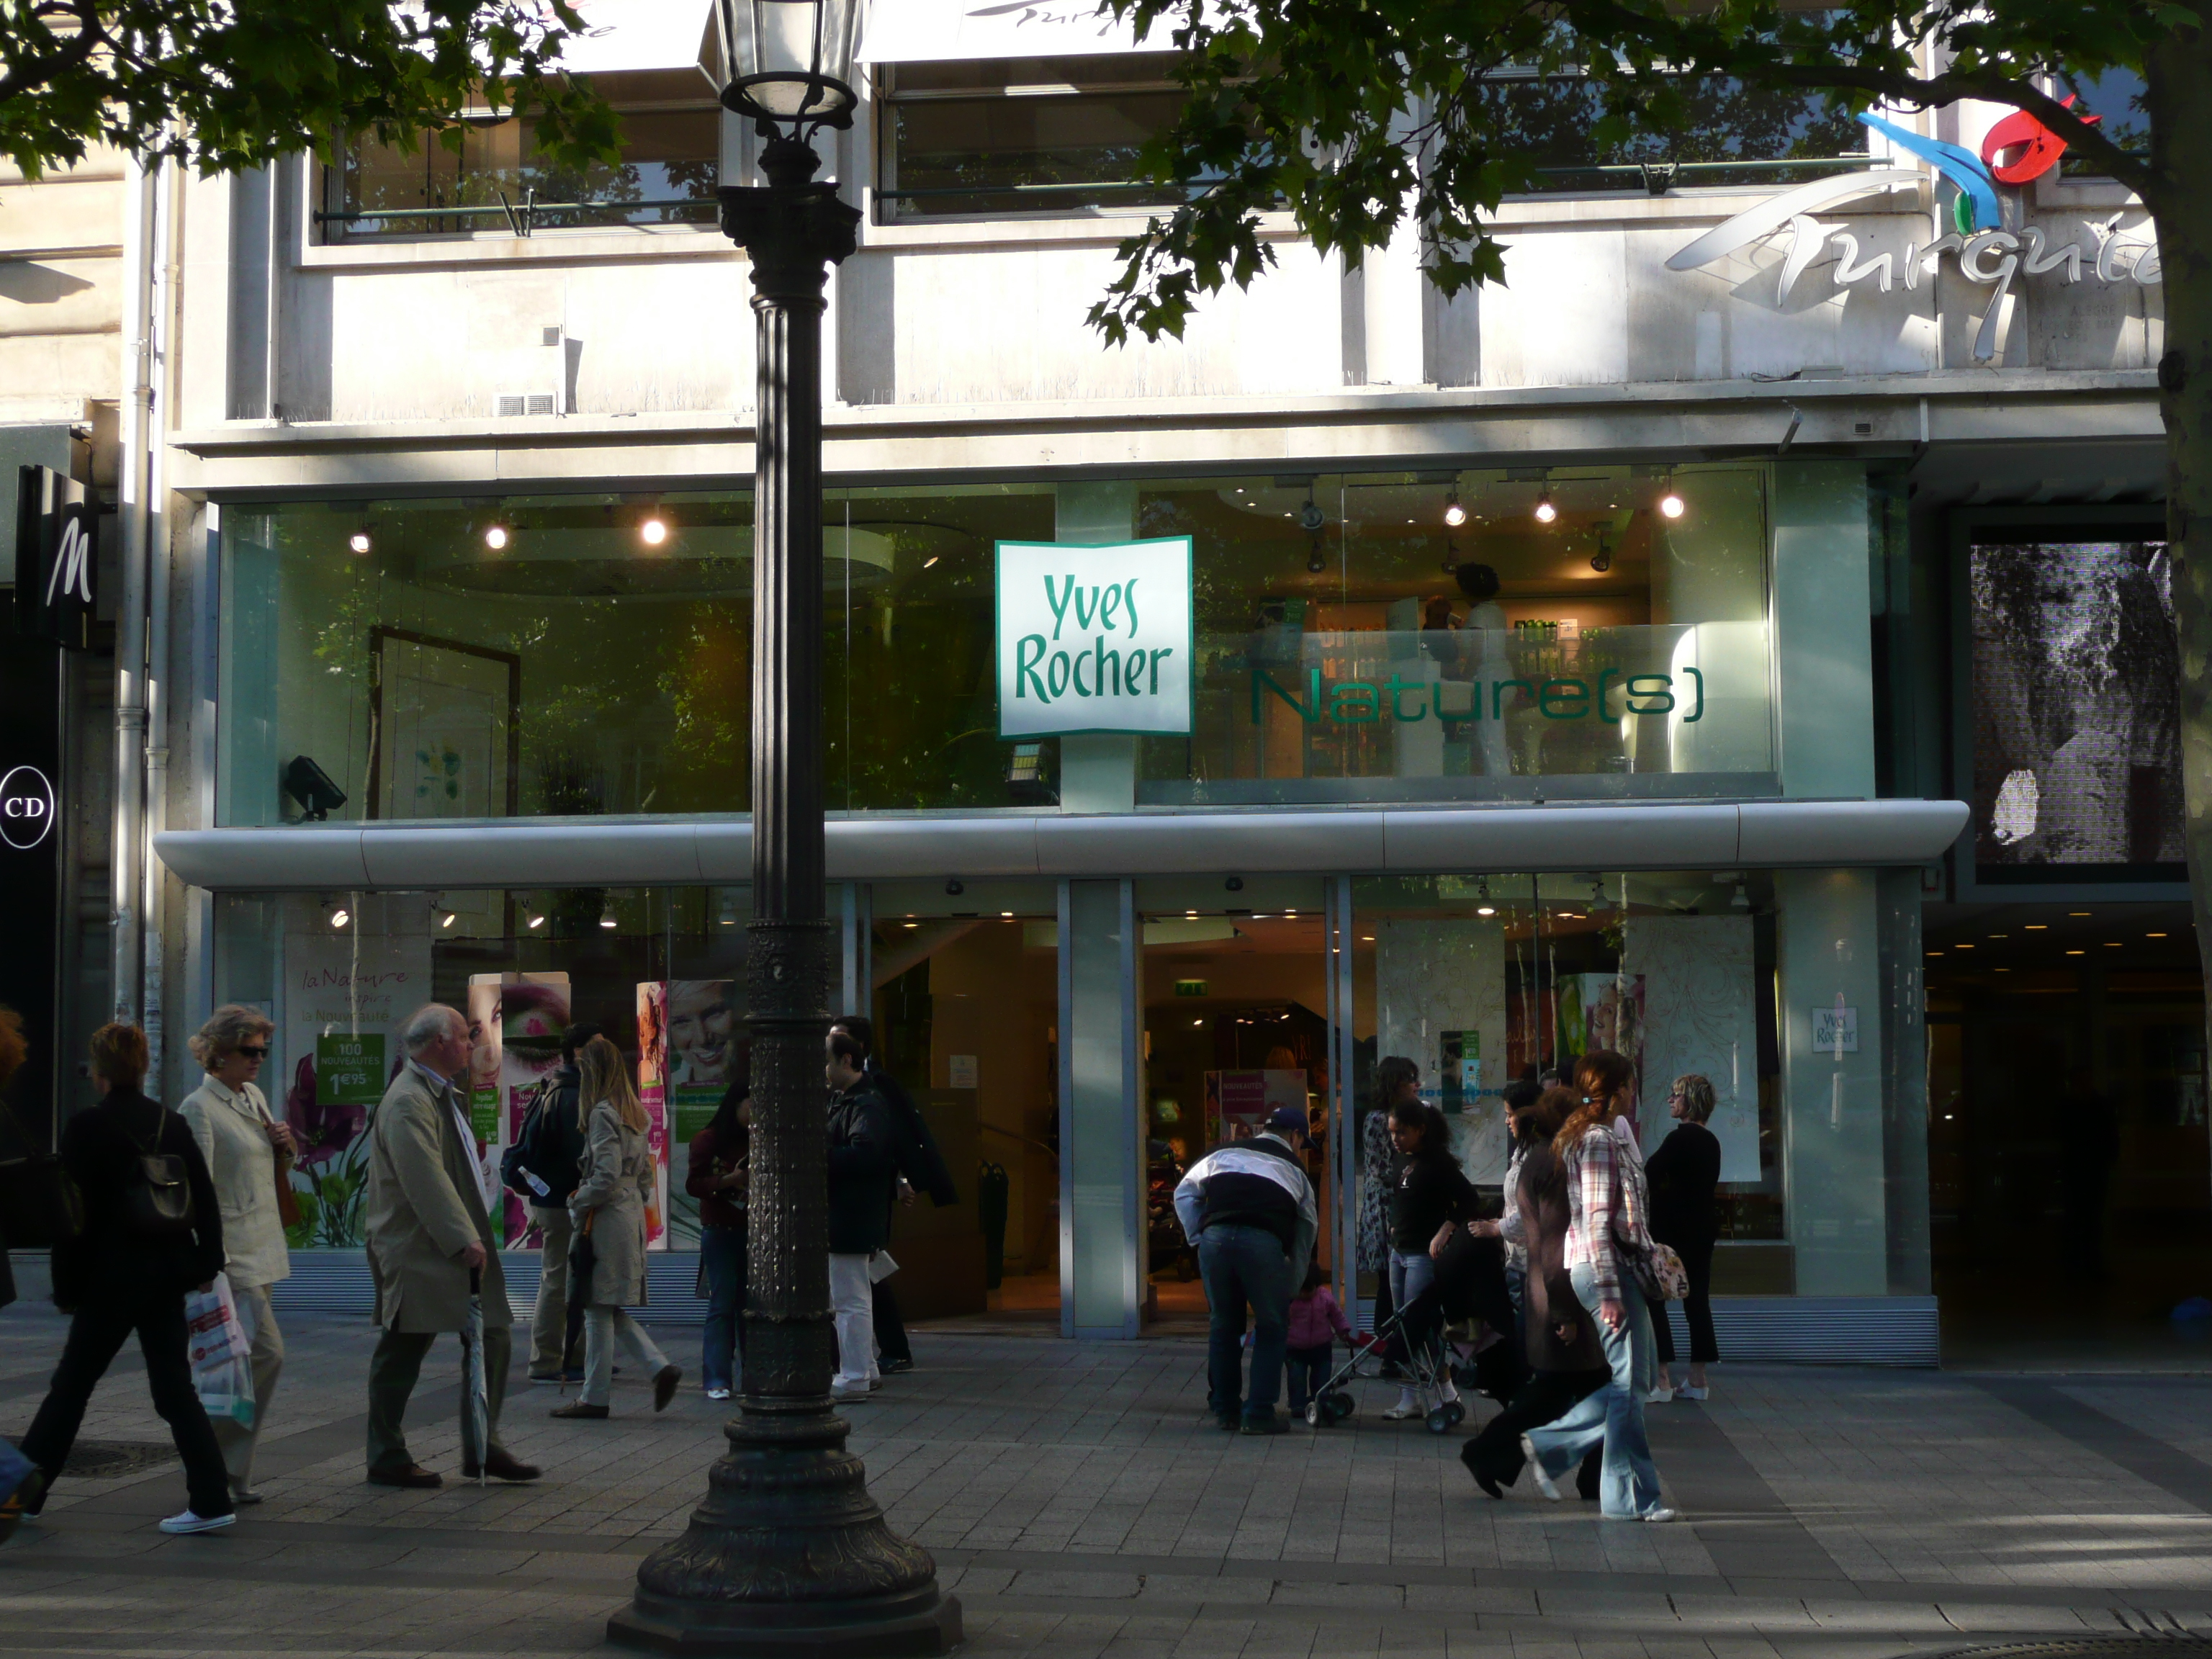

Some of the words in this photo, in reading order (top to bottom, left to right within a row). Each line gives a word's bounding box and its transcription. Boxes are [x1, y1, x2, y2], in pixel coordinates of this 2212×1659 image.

[46, 517, 91, 607] M
[1043, 574, 1139, 640] Yves
[1016, 634, 1173, 704] Rocher
[1251, 667, 1704, 724] Nature(s)
[5, 797, 45, 818] CD
[323, 963, 408, 987] Nature
[1817, 1028, 1854, 1044] Rocer
[320, 1055, 380, 1065] NOUVEAUTÉS
[339, 1043, 362, 1056] 100
[1223, 1081, 1263, 1090] NOUVEAUTÉS
